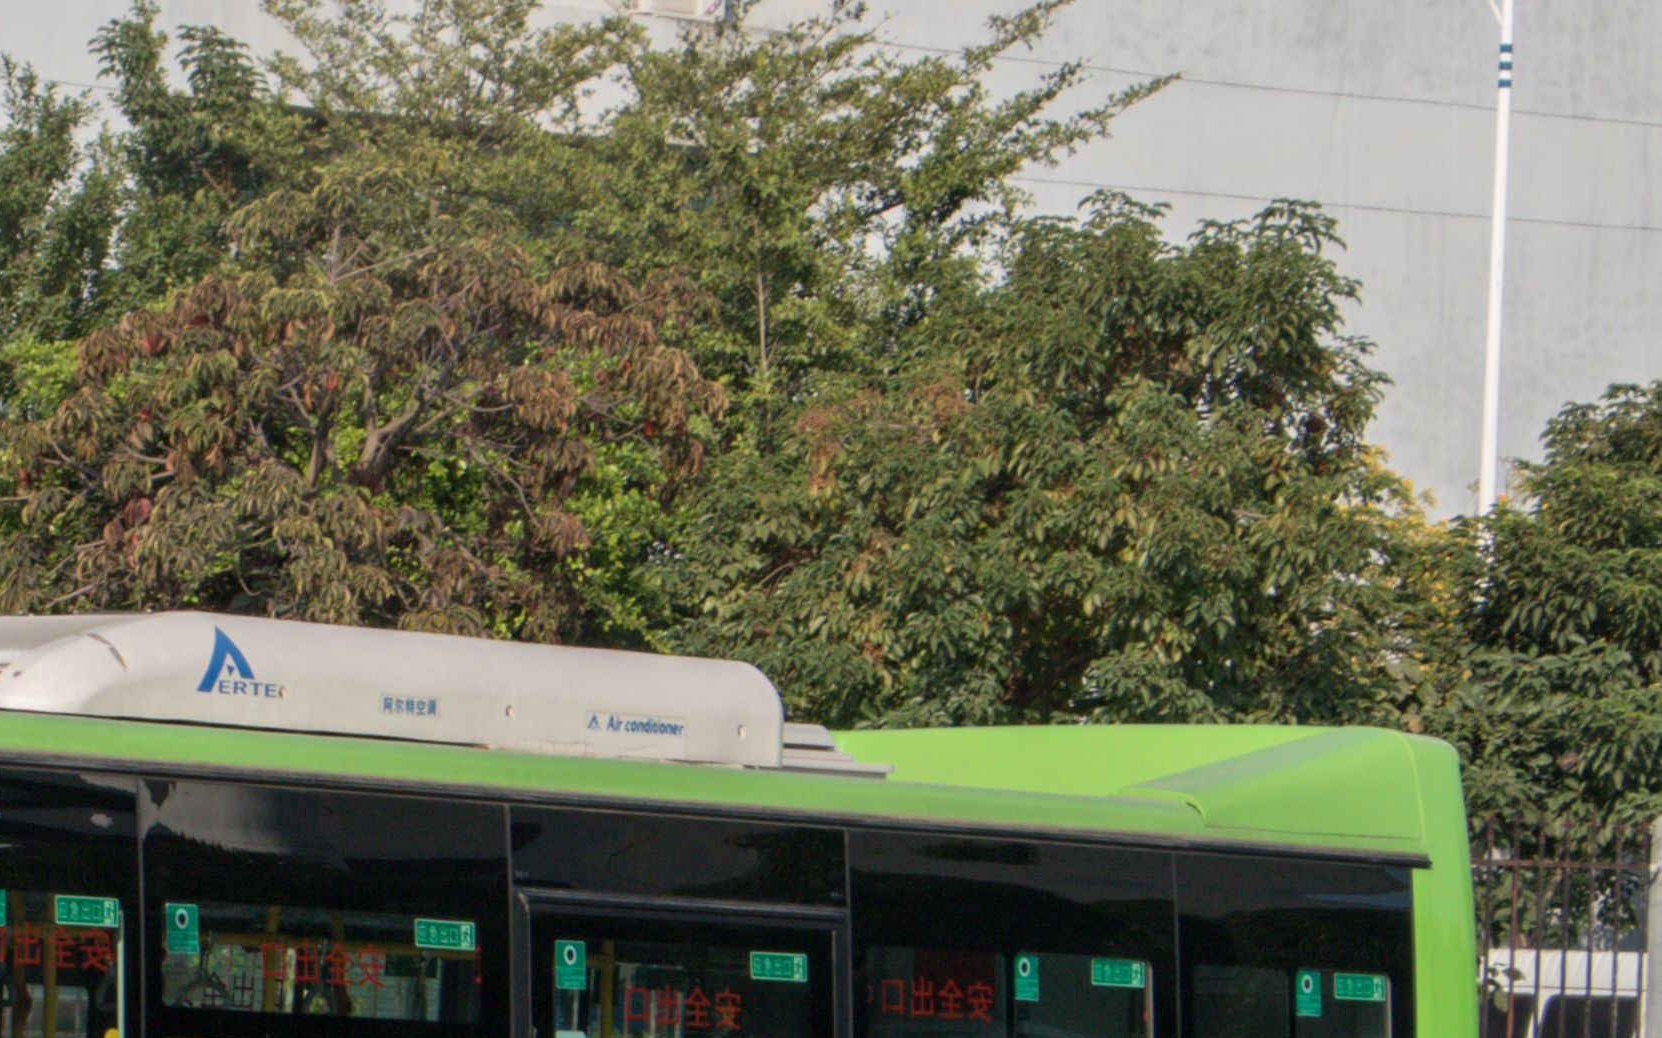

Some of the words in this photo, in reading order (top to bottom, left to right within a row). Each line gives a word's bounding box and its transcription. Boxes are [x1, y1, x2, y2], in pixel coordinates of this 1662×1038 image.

[383, 696, 436, 716] 阿尔特空调
[607, 714, 623, 731] Air
[625, 717, 684, 736] conditioner
